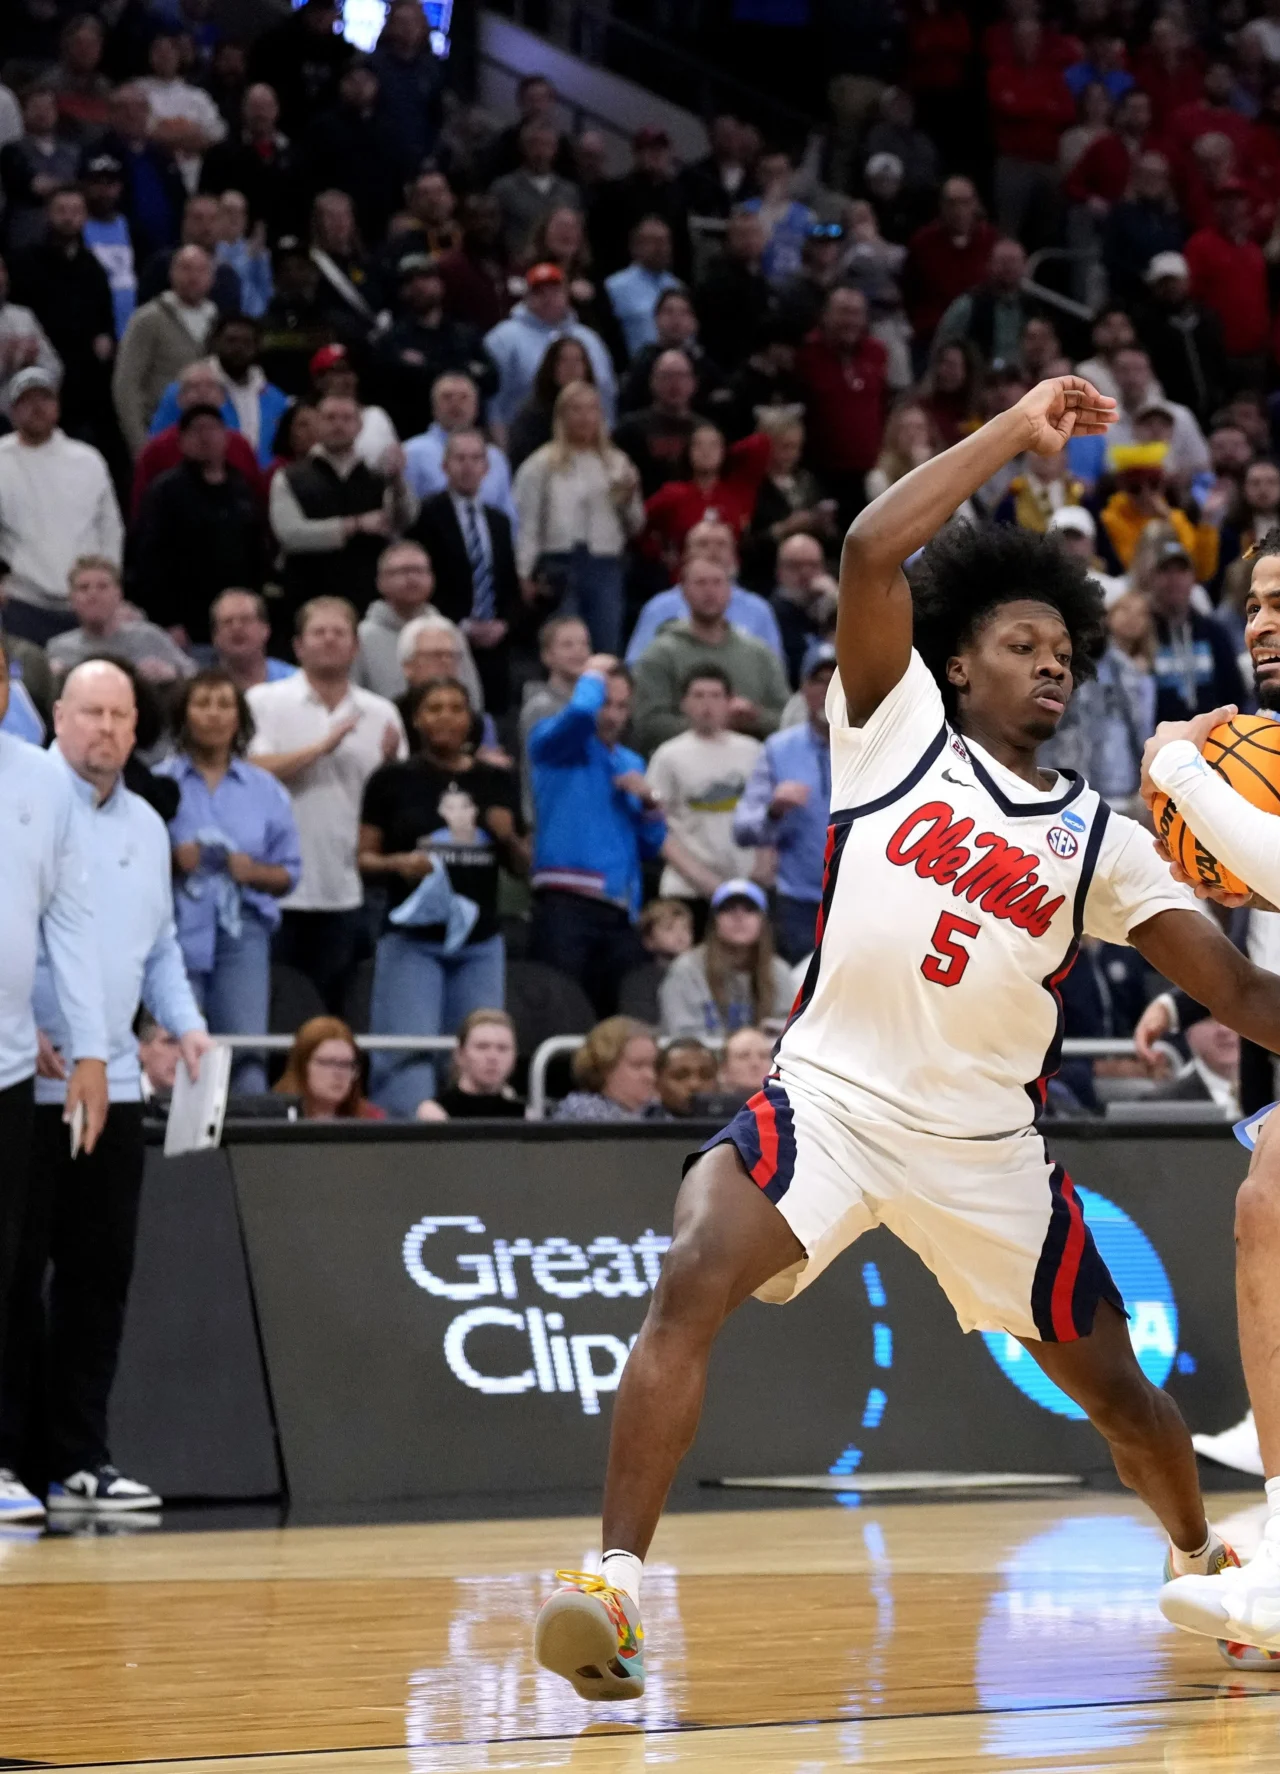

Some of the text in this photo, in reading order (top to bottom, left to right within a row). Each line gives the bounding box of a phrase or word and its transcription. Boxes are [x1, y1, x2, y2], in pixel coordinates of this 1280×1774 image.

[886, 801, 1066, 938] Ole Miss
[1048, 828, 1076, 858] SEC
[920, 910, 982, 988] 5
[402, 1216, 674, 1300] Great
[444, 1306, 642, 1415] Clip
